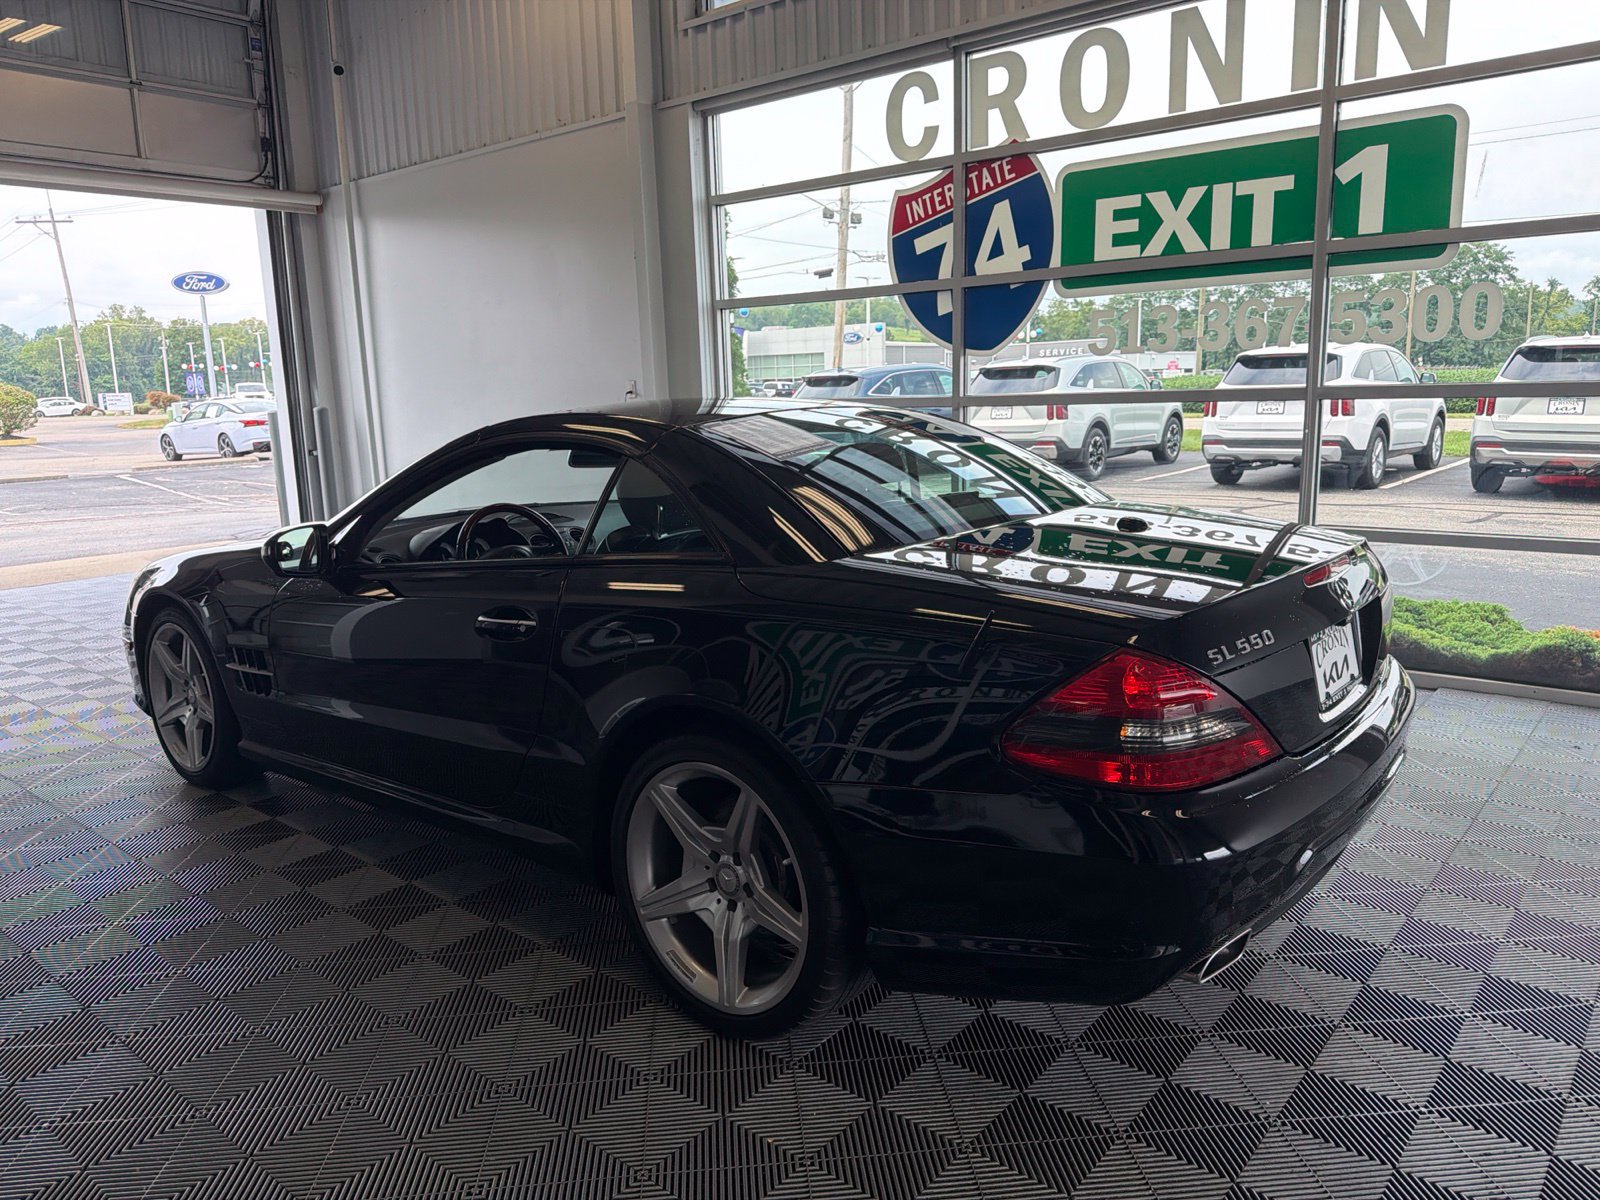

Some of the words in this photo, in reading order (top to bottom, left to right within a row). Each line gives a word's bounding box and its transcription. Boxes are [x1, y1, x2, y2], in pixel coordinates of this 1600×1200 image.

[885, 0, 1451, 162] CRONIN
[906, 157, 1016, 224] INTERTATE
[1094, 174, 1295, 262] EXIT
[1334, 143, 1389, 236] 1
[182, 274, 217, 290] Ford
[913, 198, 1032, 317] 74
[1039, 347, 1085, 358] SERVICE
[1315, 625, 1351, 669] CRONIN
[1322, 653, 1350, 690] KIA
